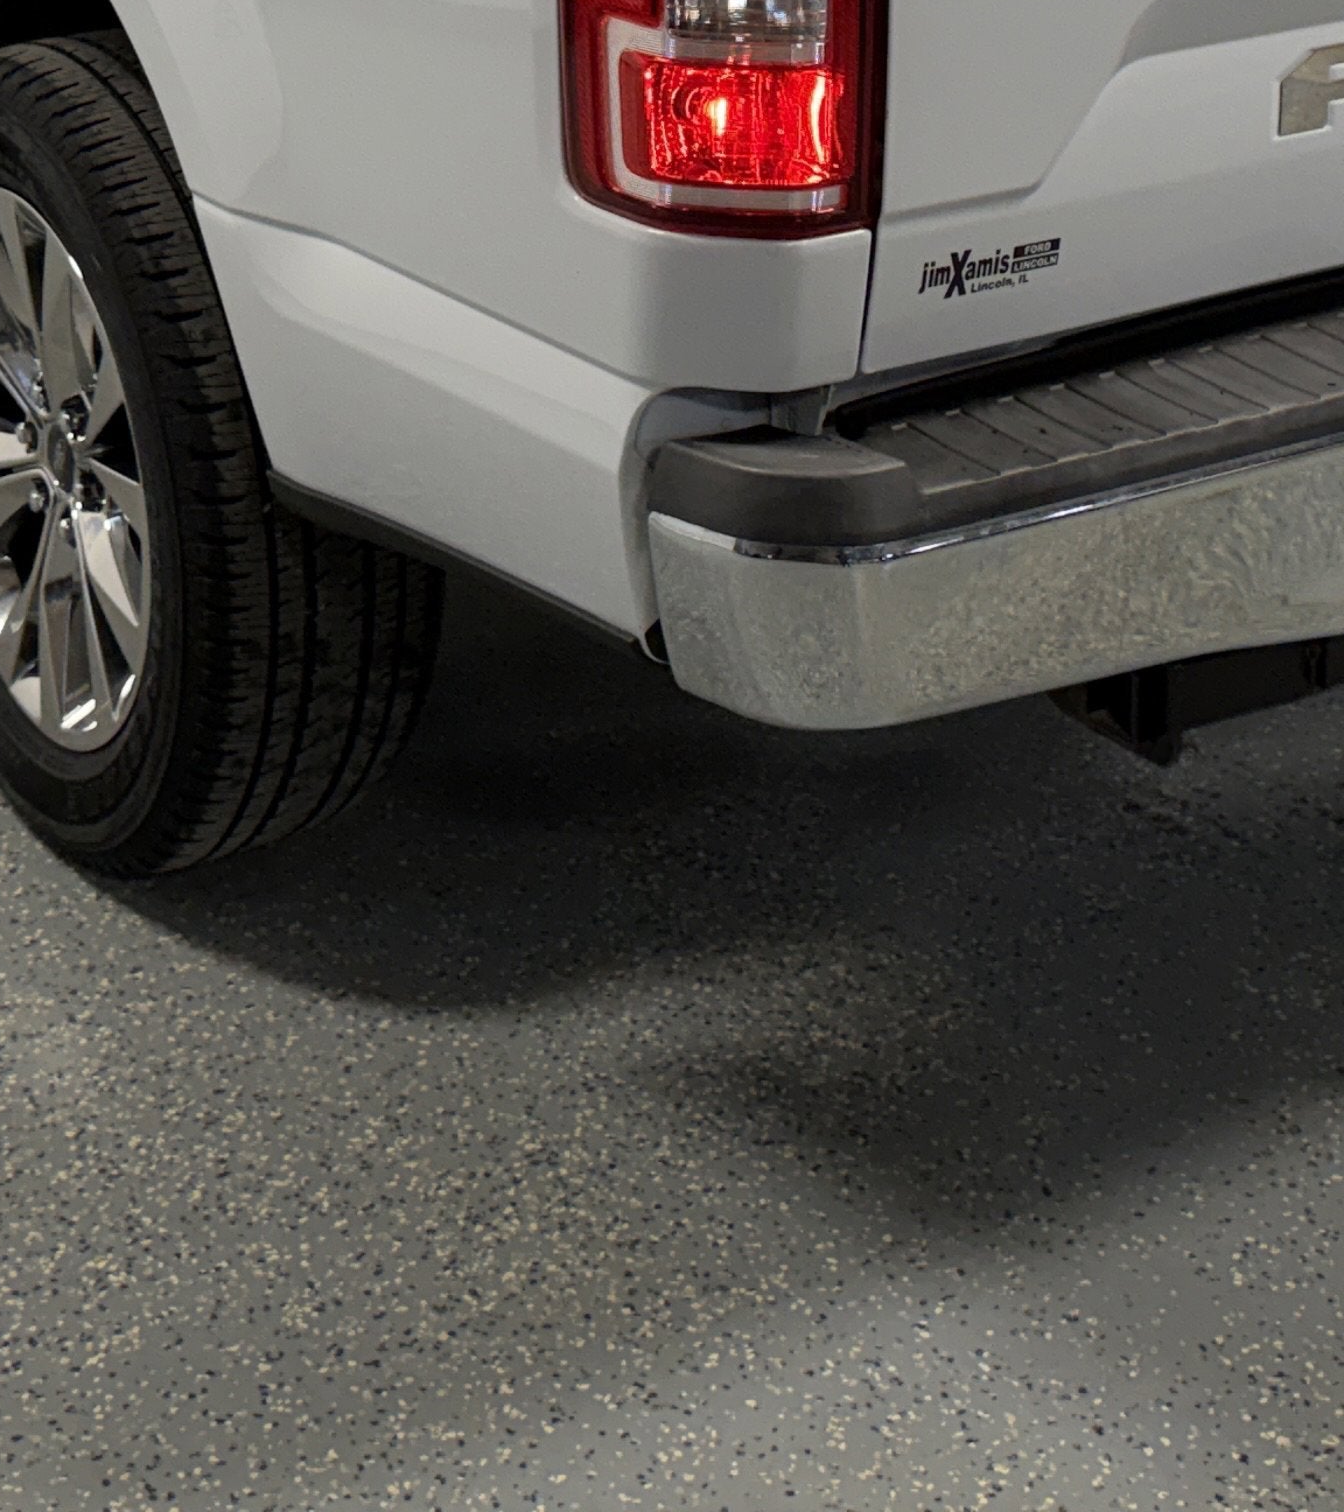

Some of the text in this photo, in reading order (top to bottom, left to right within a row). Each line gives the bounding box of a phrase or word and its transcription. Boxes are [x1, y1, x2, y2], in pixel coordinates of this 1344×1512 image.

[1024, 240, 1052, 257] FORD
[1013, 255, 1058, 273] LINCOLN
[970, 274, 1029, 294] Lincoln, IL
